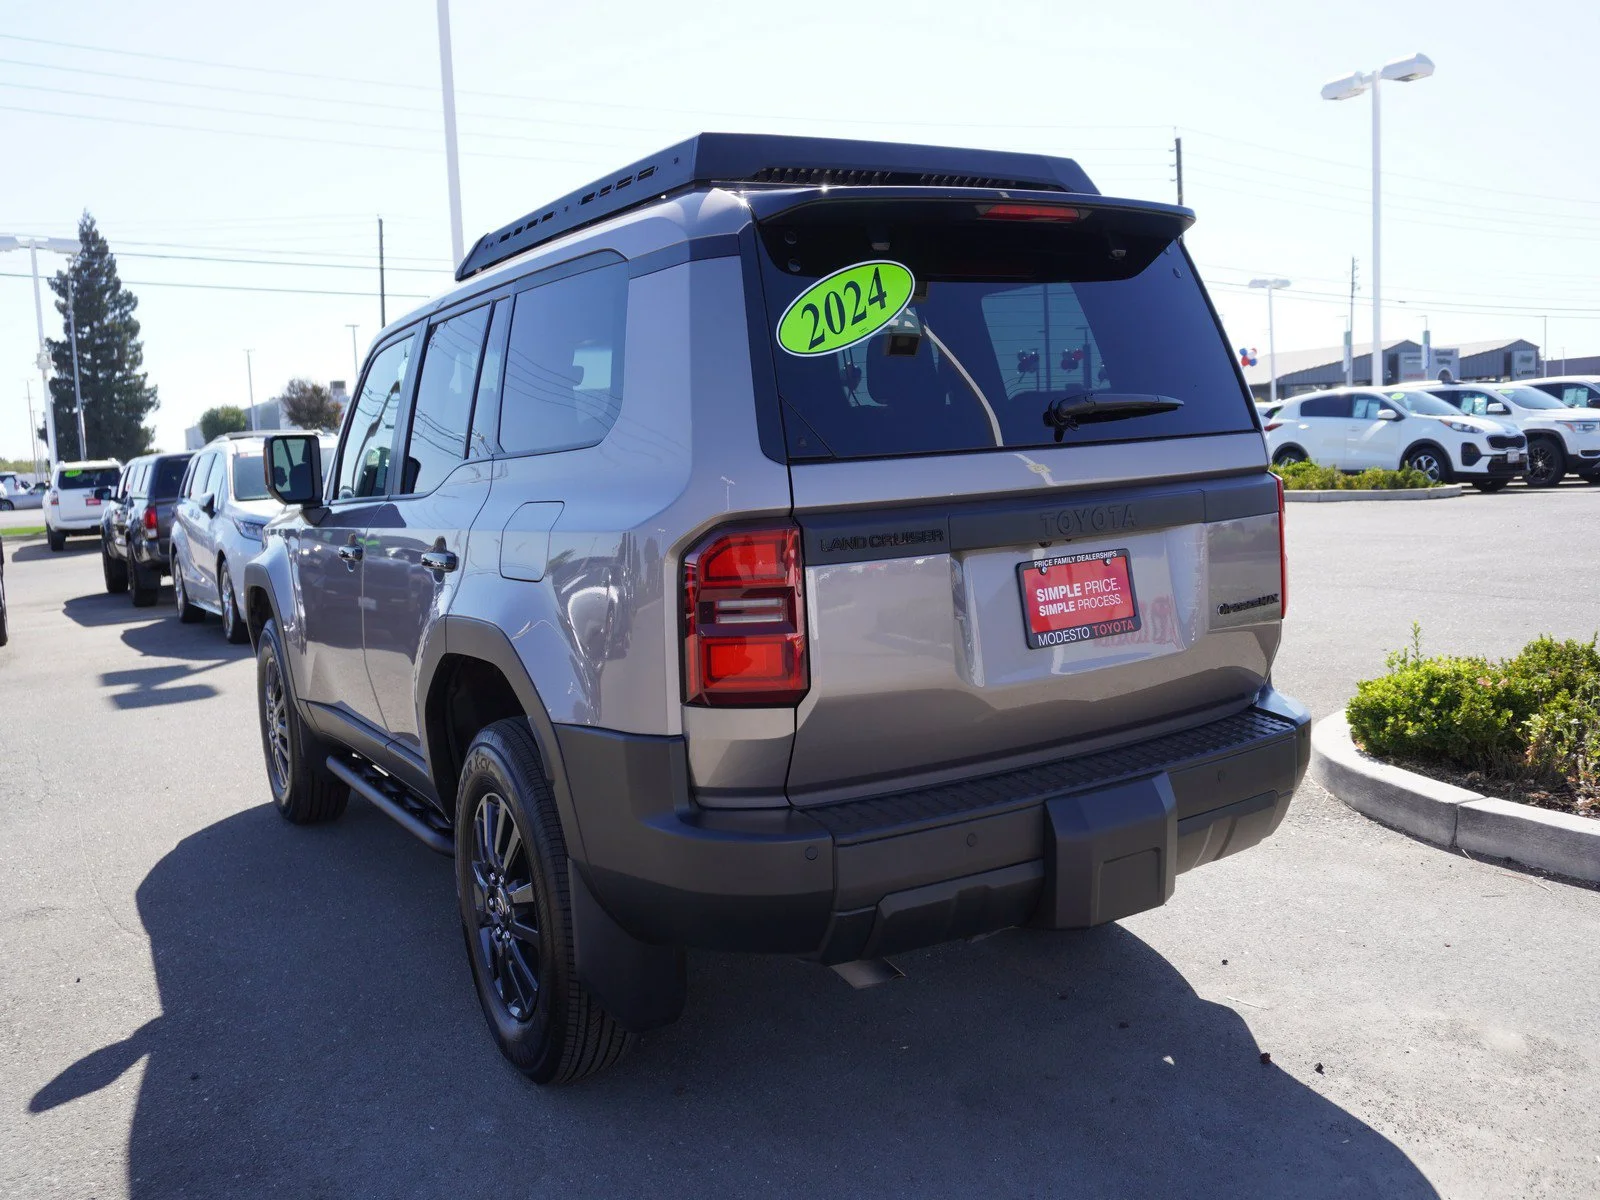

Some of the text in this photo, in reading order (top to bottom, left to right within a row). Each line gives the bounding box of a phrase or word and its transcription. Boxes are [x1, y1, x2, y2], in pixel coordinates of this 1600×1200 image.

[801, 266, 888, 350] 2024
[1040, 504, 1137, 537] TOYOTA
[820, 529, 944, 552] LAND CRUISER
[1033, 550, 1117, 568] PRICE FAMILY DEALERSHIPS
[1036, 577, 1121, 602] SIMPLE PRICE.
[1039, 593, 1124, 617] SIMPLE PROCESS.
[1038, 620, 1135, 646] MODESTO TOYOTA
